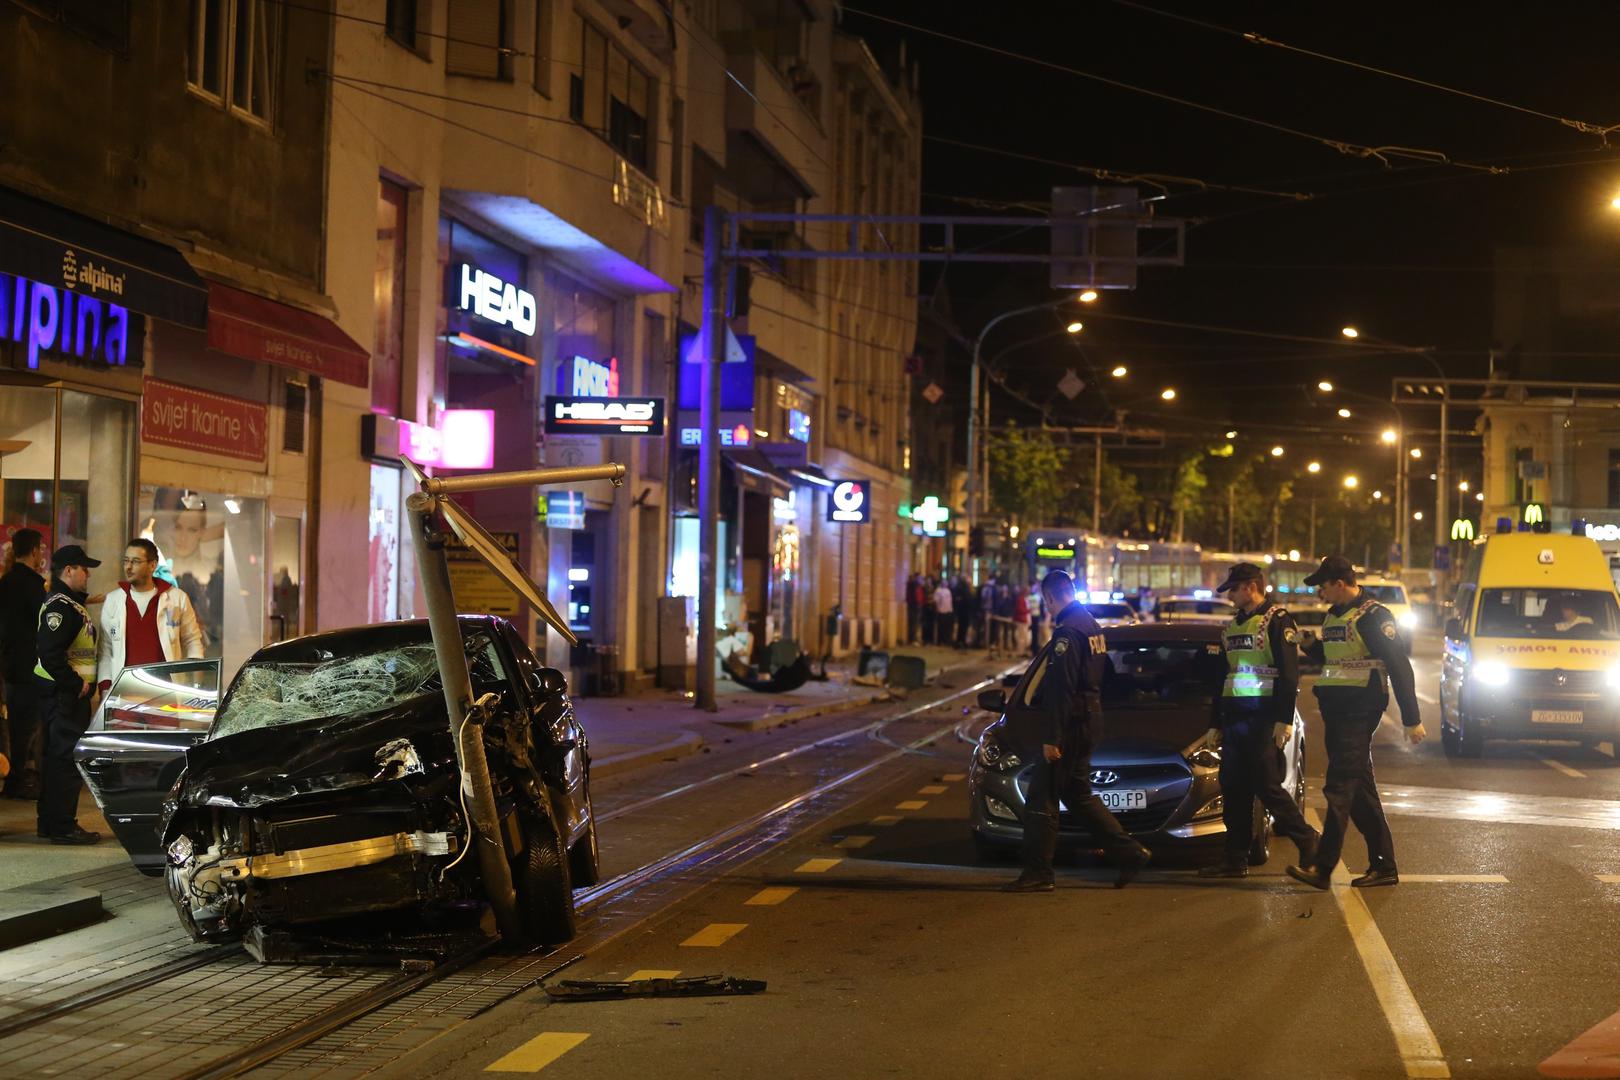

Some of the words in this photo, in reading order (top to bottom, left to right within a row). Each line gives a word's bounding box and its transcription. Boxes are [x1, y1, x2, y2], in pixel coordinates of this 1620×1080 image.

[79, 262, 123, 296] alpina
[460, 263, 537, 337] HEAD
[152, 397, 188, 434] svijet
[192, 402, 241, 441] tkanine
[555, 402, 653, 420] HEAD
[681, 427, 733, 446] ERTE
